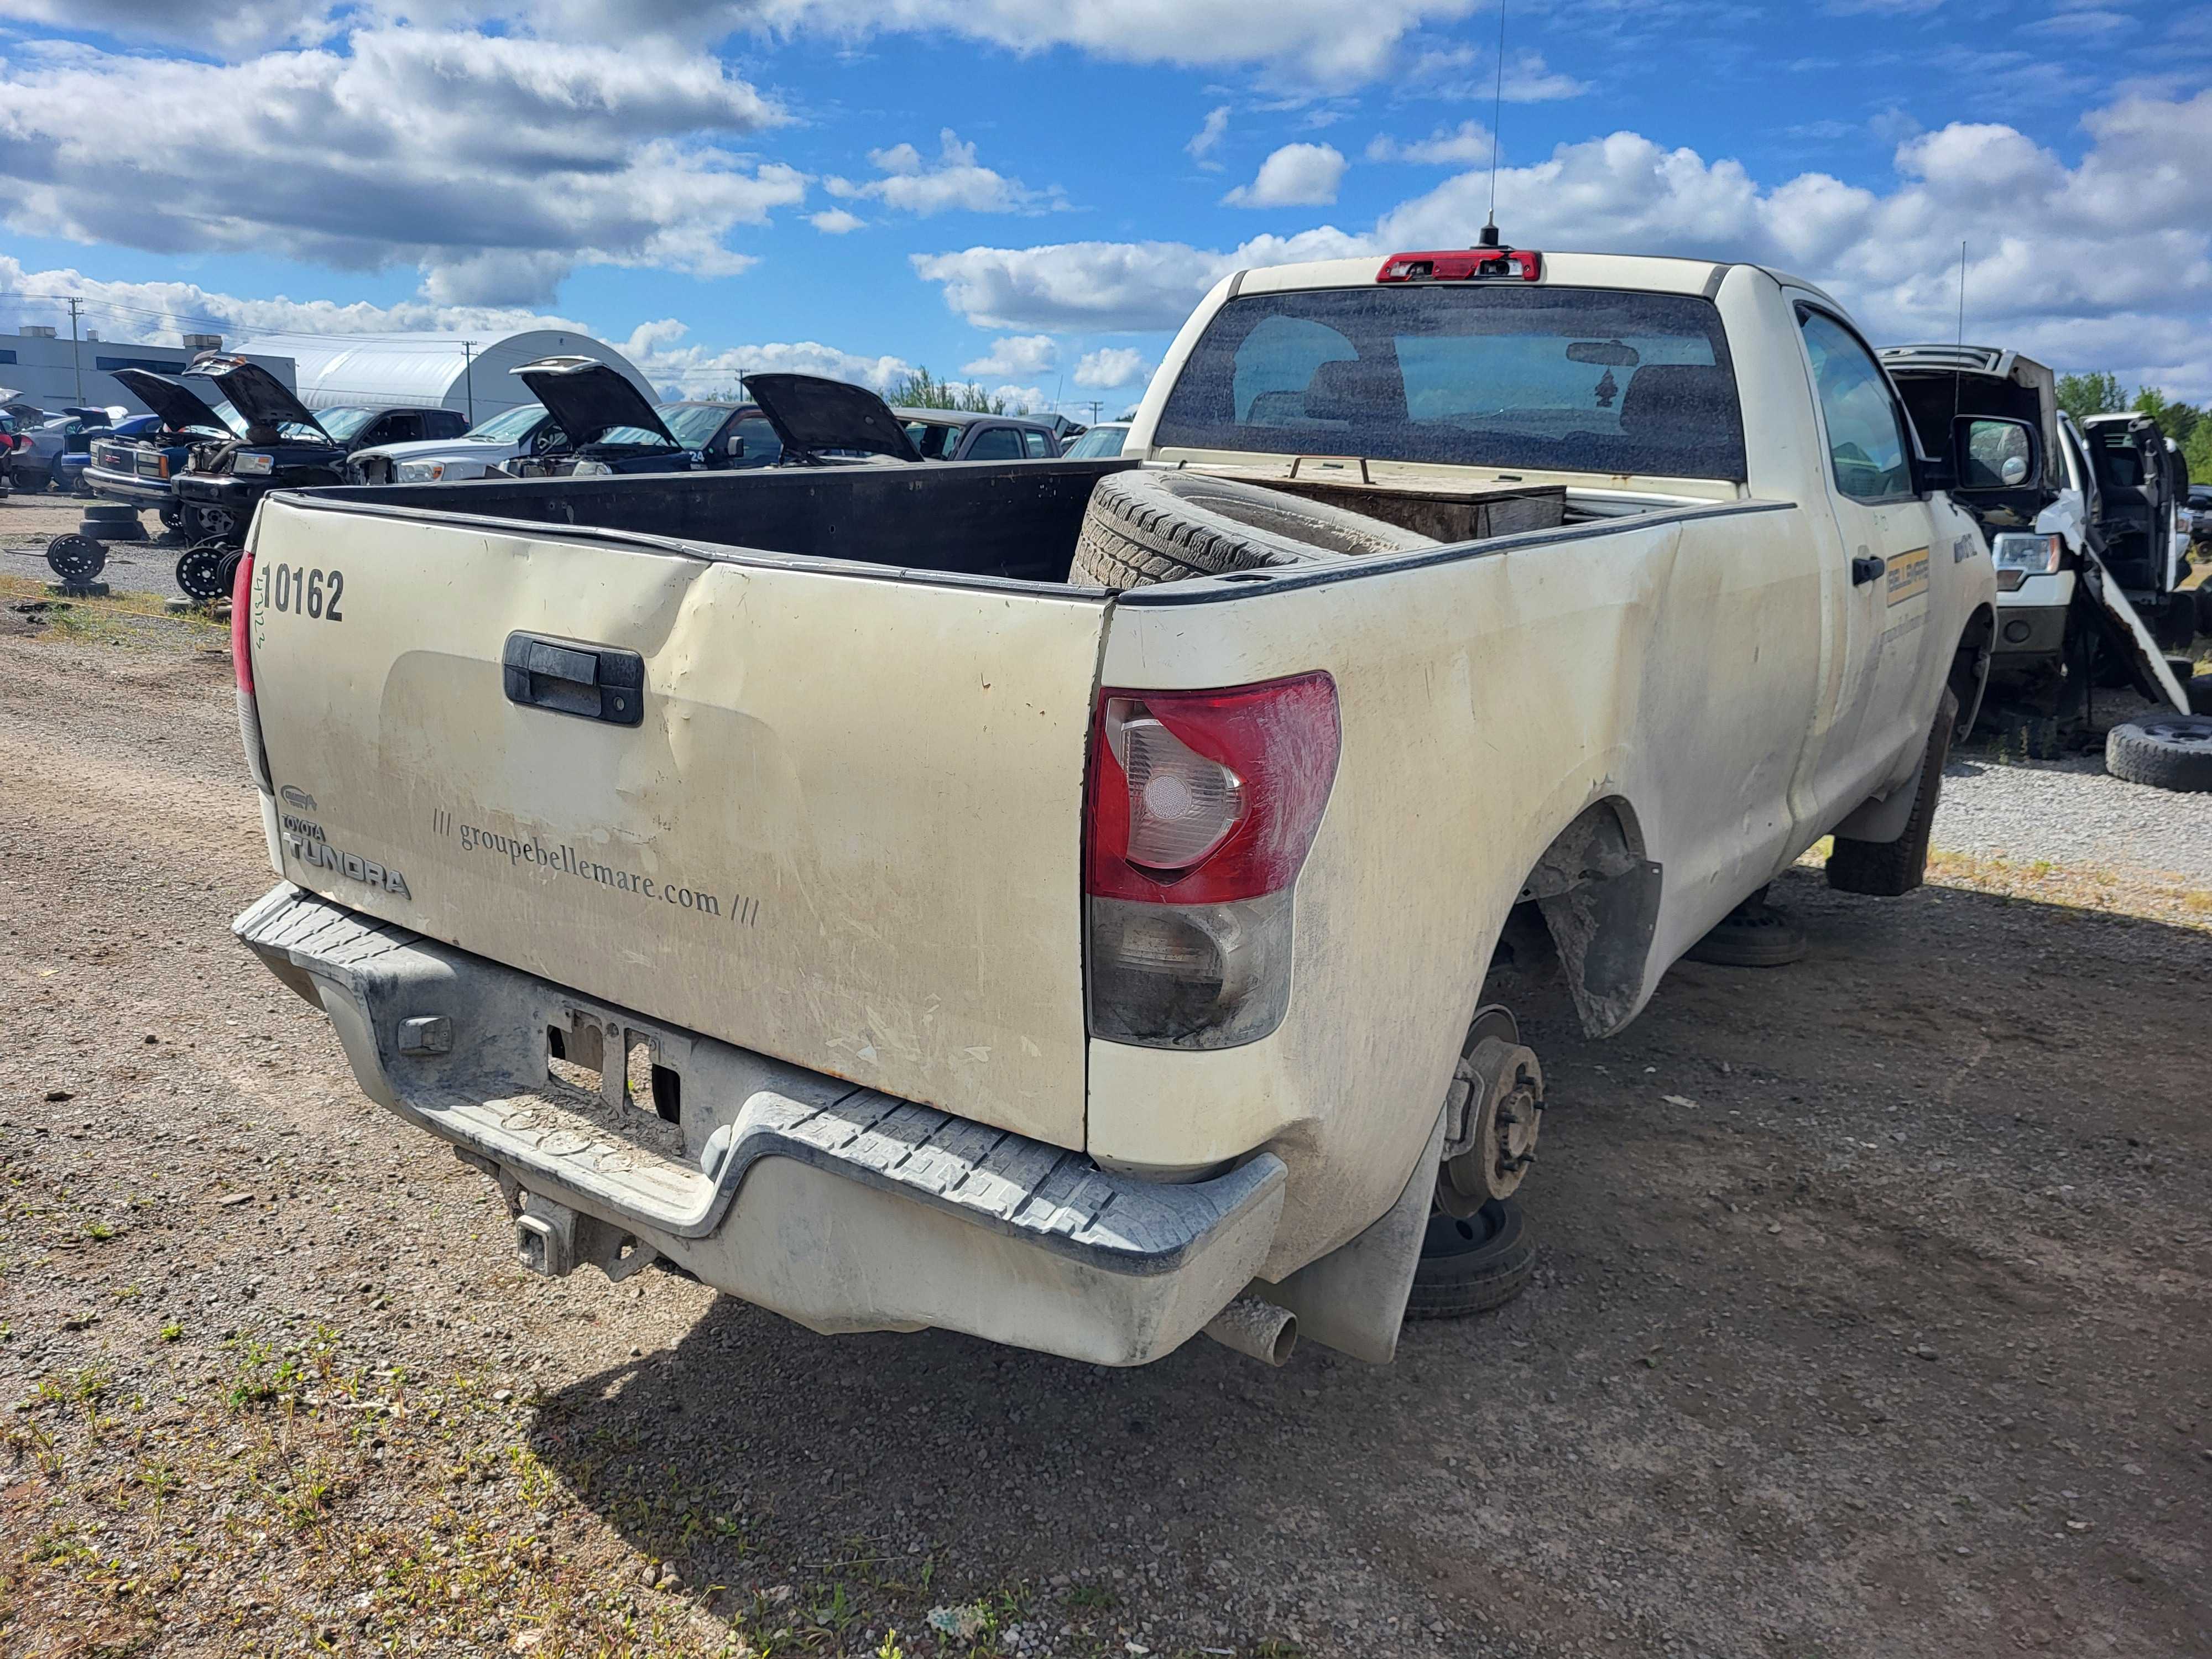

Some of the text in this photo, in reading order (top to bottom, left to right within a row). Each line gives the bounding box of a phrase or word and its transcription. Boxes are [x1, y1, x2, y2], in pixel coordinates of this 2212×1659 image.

[689, 451, 705, 462] 24
[262, 561, 343, 622] 10162
[281, 813, 326, 842] TOYOTA
[283, 832, 411, 900] TUNDRA
[460, 823, 721, 916] groupebellemare.com
